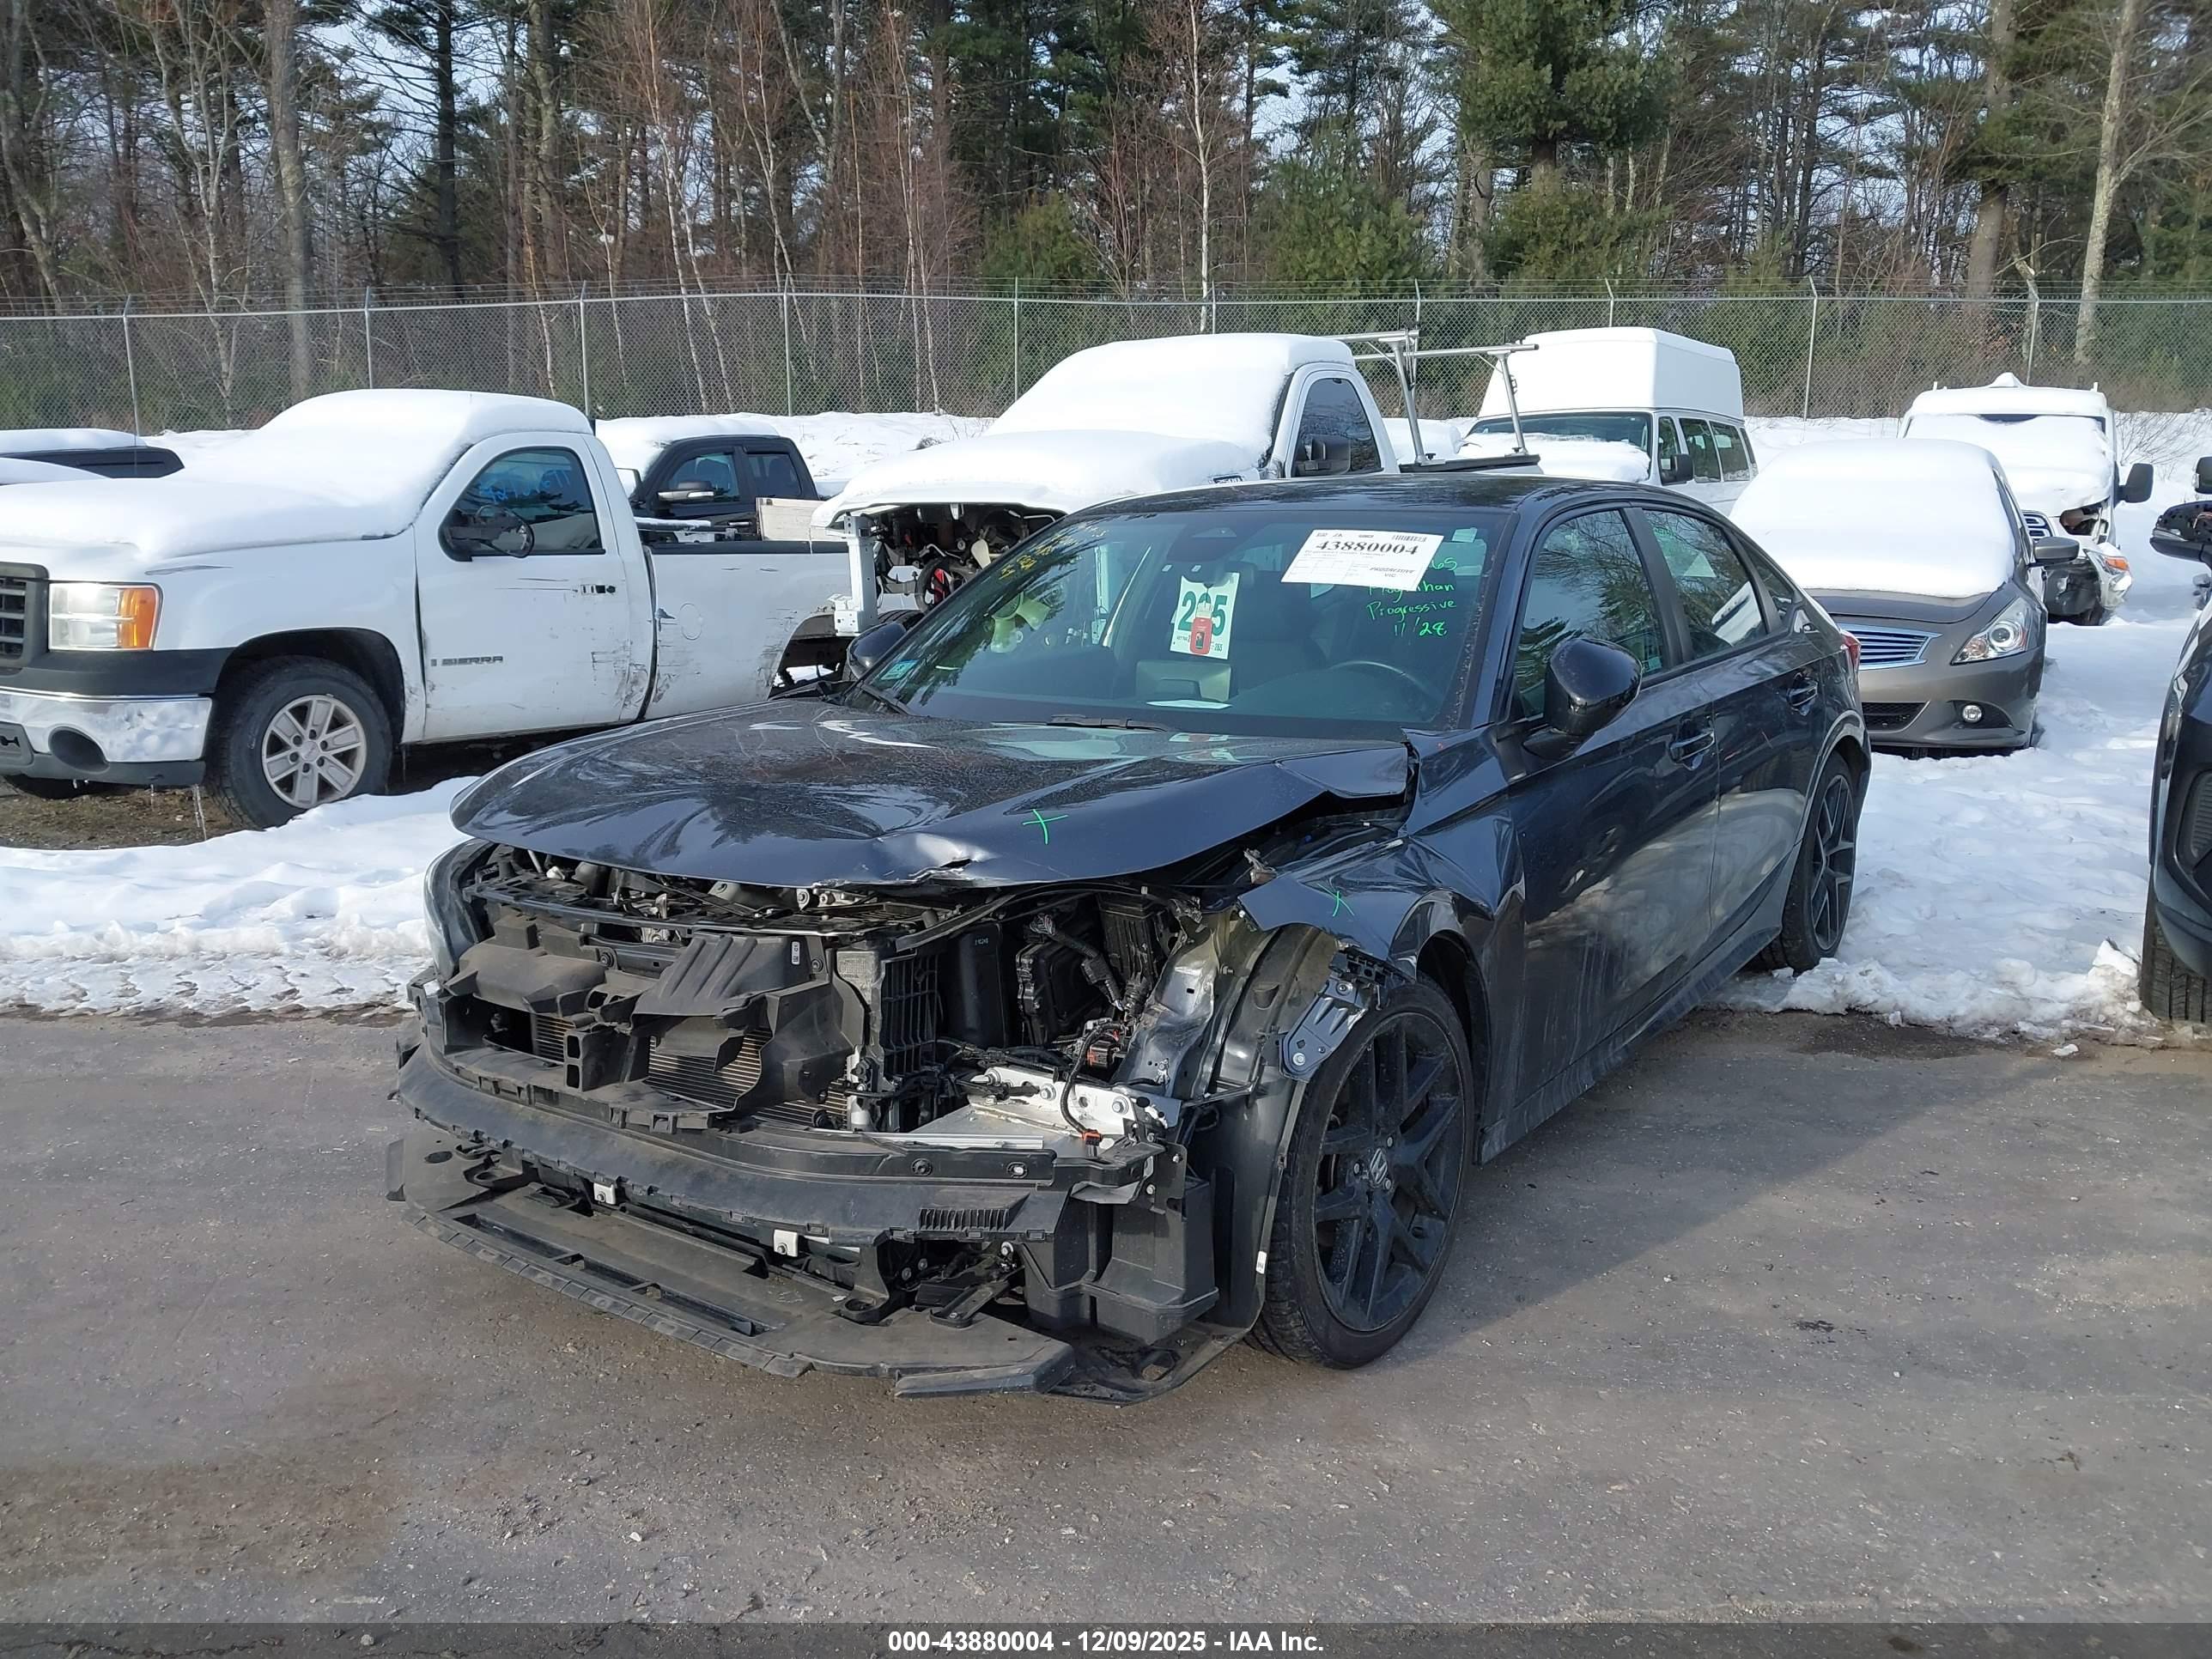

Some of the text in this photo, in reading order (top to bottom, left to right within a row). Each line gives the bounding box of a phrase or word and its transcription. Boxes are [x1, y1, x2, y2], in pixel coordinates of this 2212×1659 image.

[1316, 540, 1419, 555] 43880004
[1178, 591, 1228, 636] 25
[1366, 600, 1457, 623] Progressive
[441, 655, 503, 666] SIERRA
